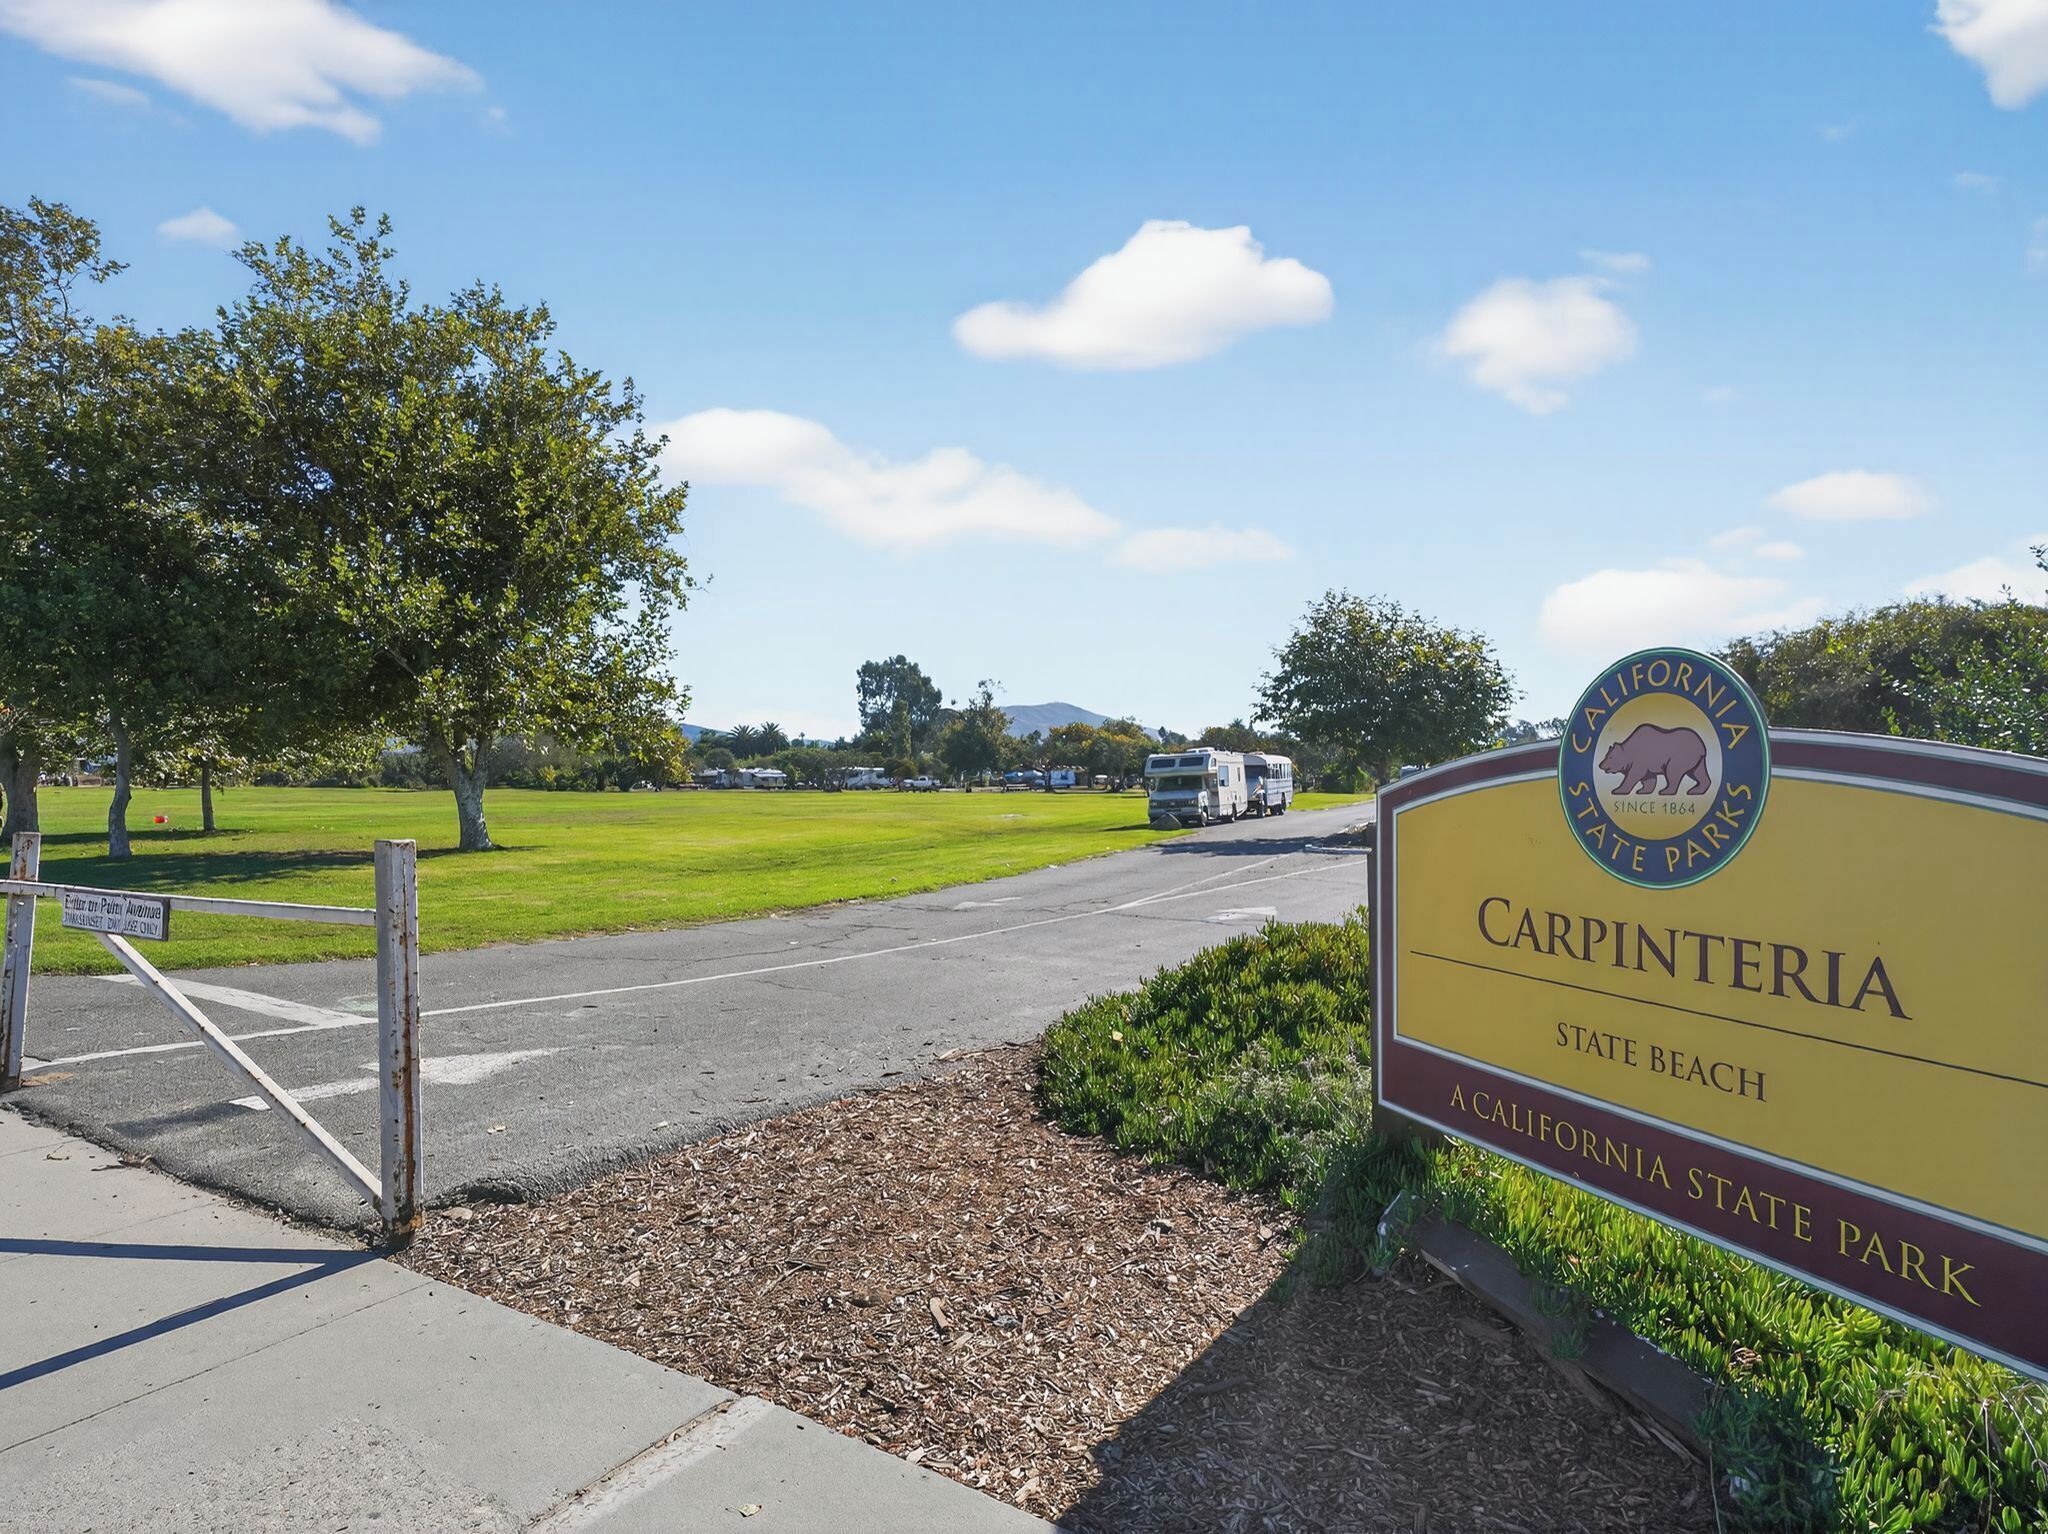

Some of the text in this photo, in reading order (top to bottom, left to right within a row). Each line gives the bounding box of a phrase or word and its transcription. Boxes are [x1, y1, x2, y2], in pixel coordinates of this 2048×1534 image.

[1572, 659, 1750, 753] CALIFORNIA
[1568, 781, 1752, 872] STATE PARKS
[1614, 800, 1696, 815] SINCE 1864
[1477, 896, 1913, 1021] CARPINTERIA
[1556, 1021, 1767, 1102] STATE BEACH
[1450, 1083, 1982, 1307] A CALIFORNIA STATE PARK
